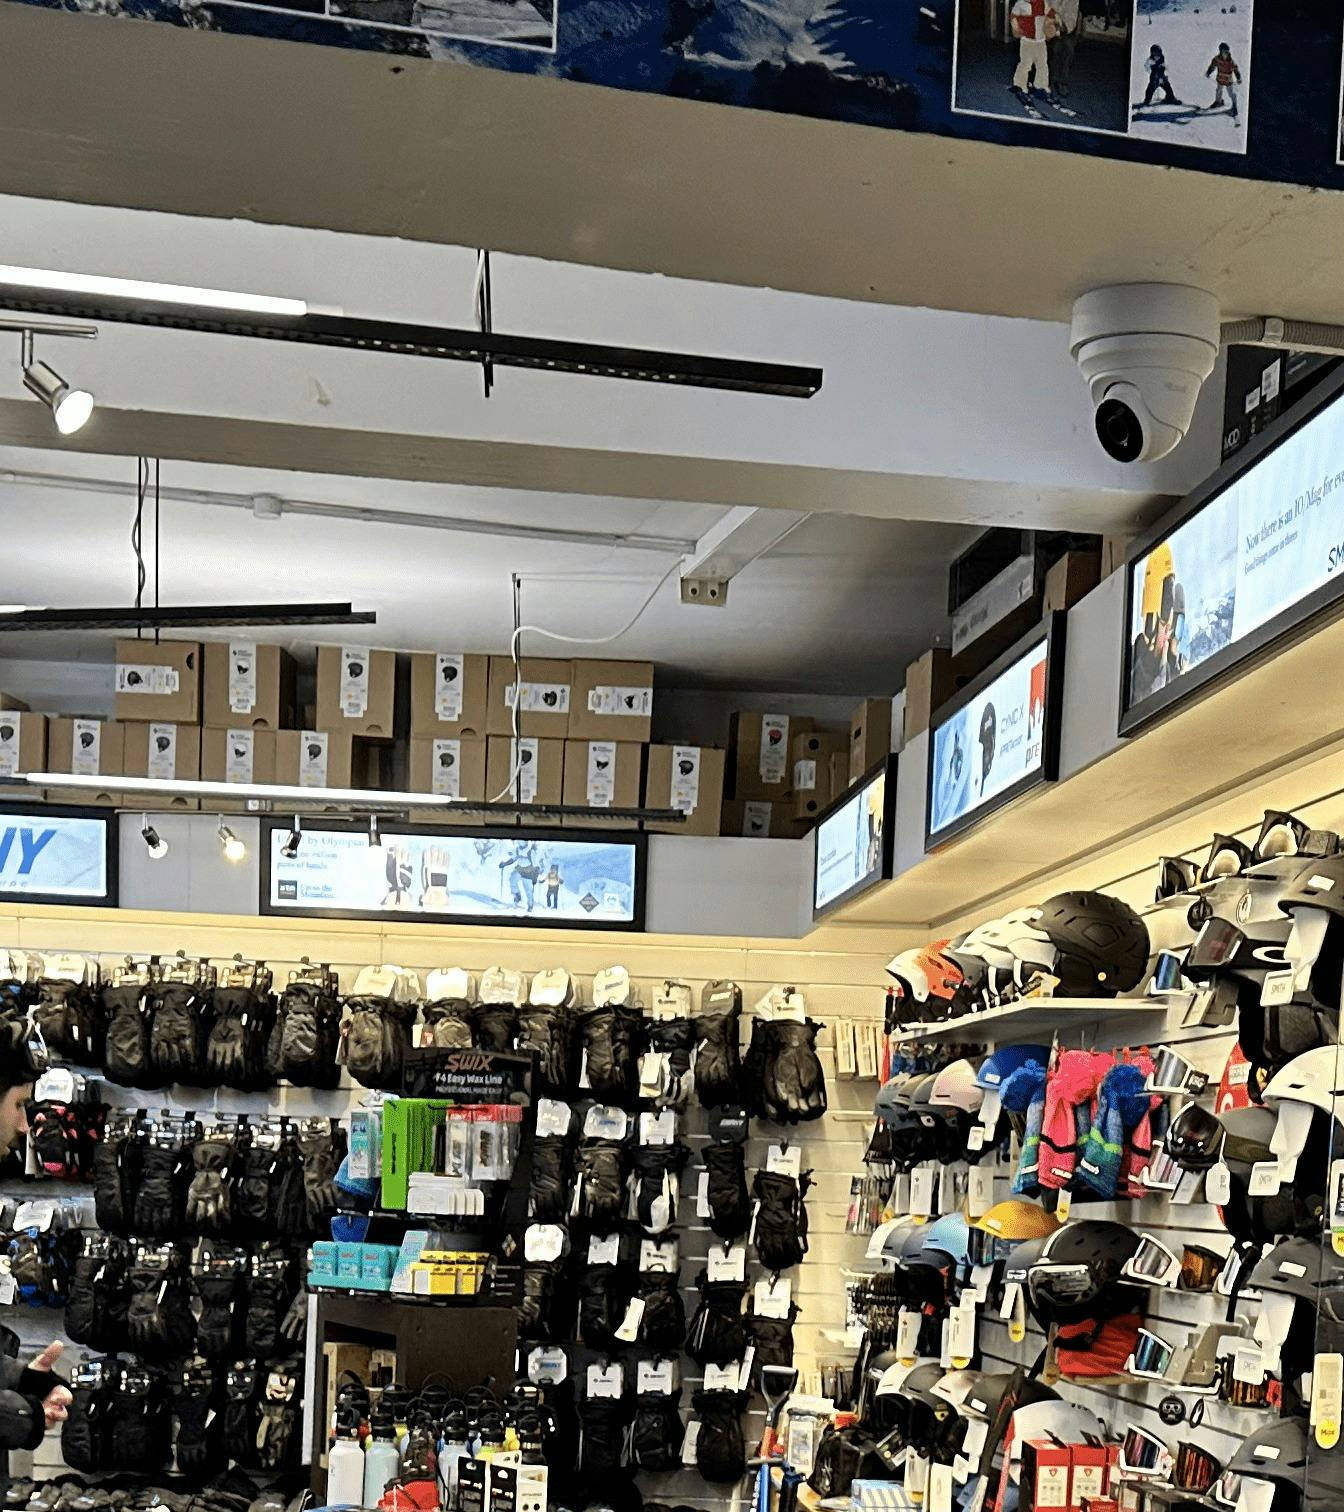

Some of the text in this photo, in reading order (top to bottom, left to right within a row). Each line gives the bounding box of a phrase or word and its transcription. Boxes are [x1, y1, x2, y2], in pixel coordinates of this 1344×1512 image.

[445, 1054, 494, 1071] SWIX
[447, 1073, 465, 1084] Easy
[467, 1074, 484, 1084] Wax
[485, 1074, 503, 1084] Line
